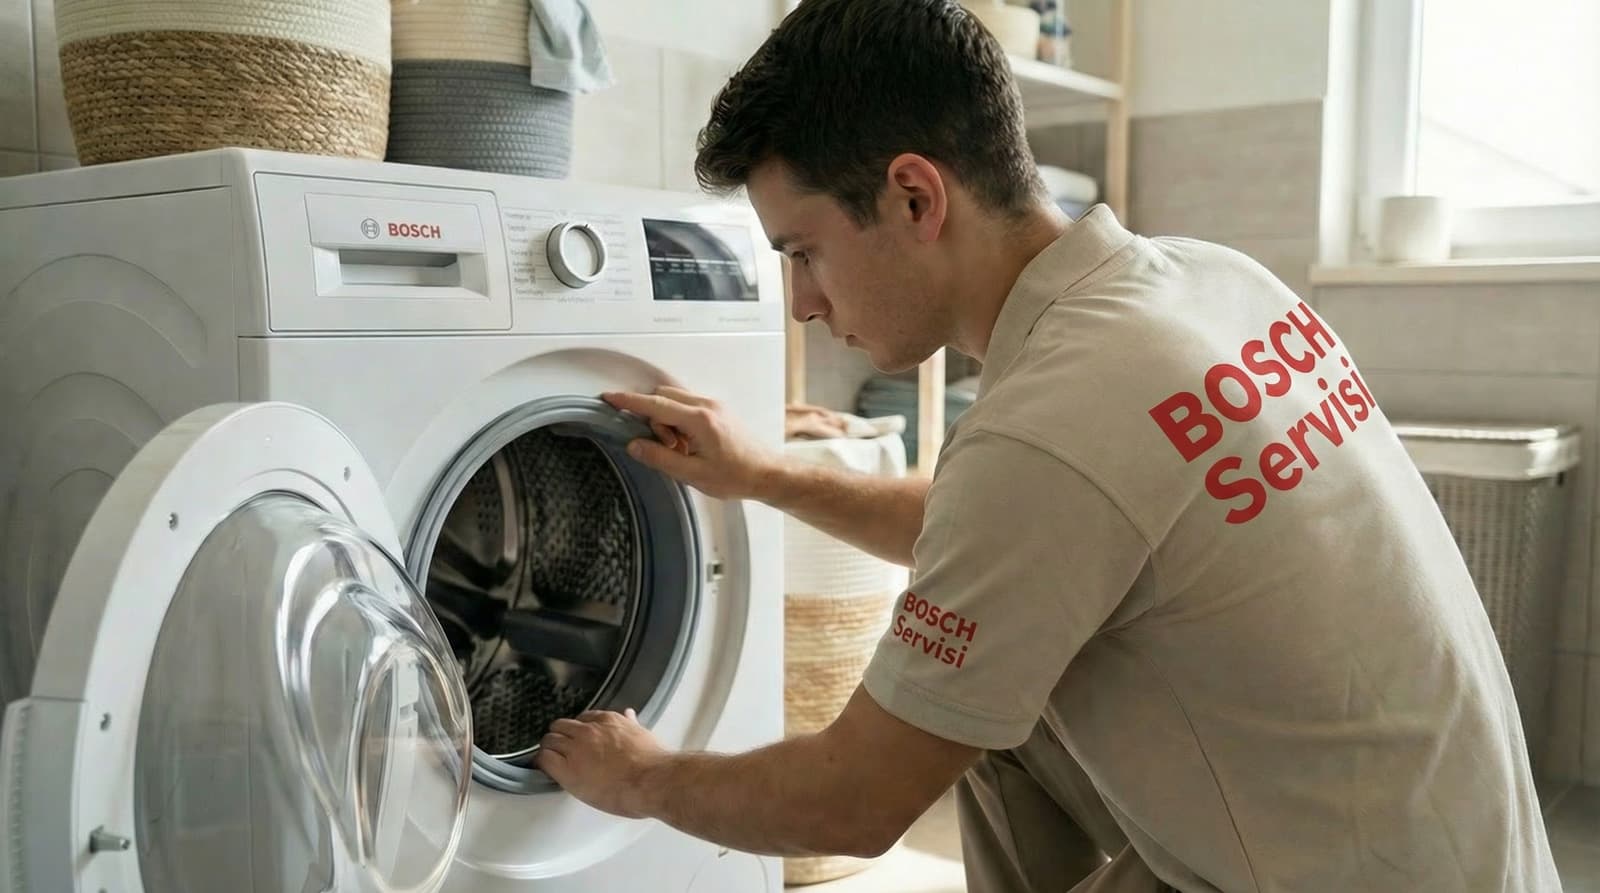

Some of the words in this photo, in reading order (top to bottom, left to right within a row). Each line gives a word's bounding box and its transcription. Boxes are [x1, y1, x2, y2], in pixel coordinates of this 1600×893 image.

[388, 223, 441, 239] BOSCH
[1149, 302, 1336, 463] BOSCH
[1204, 357, 1377, 524] Servisi
[893, 615, 969, 669] Servisi
[903, 591, 977, 642] BOSCH
